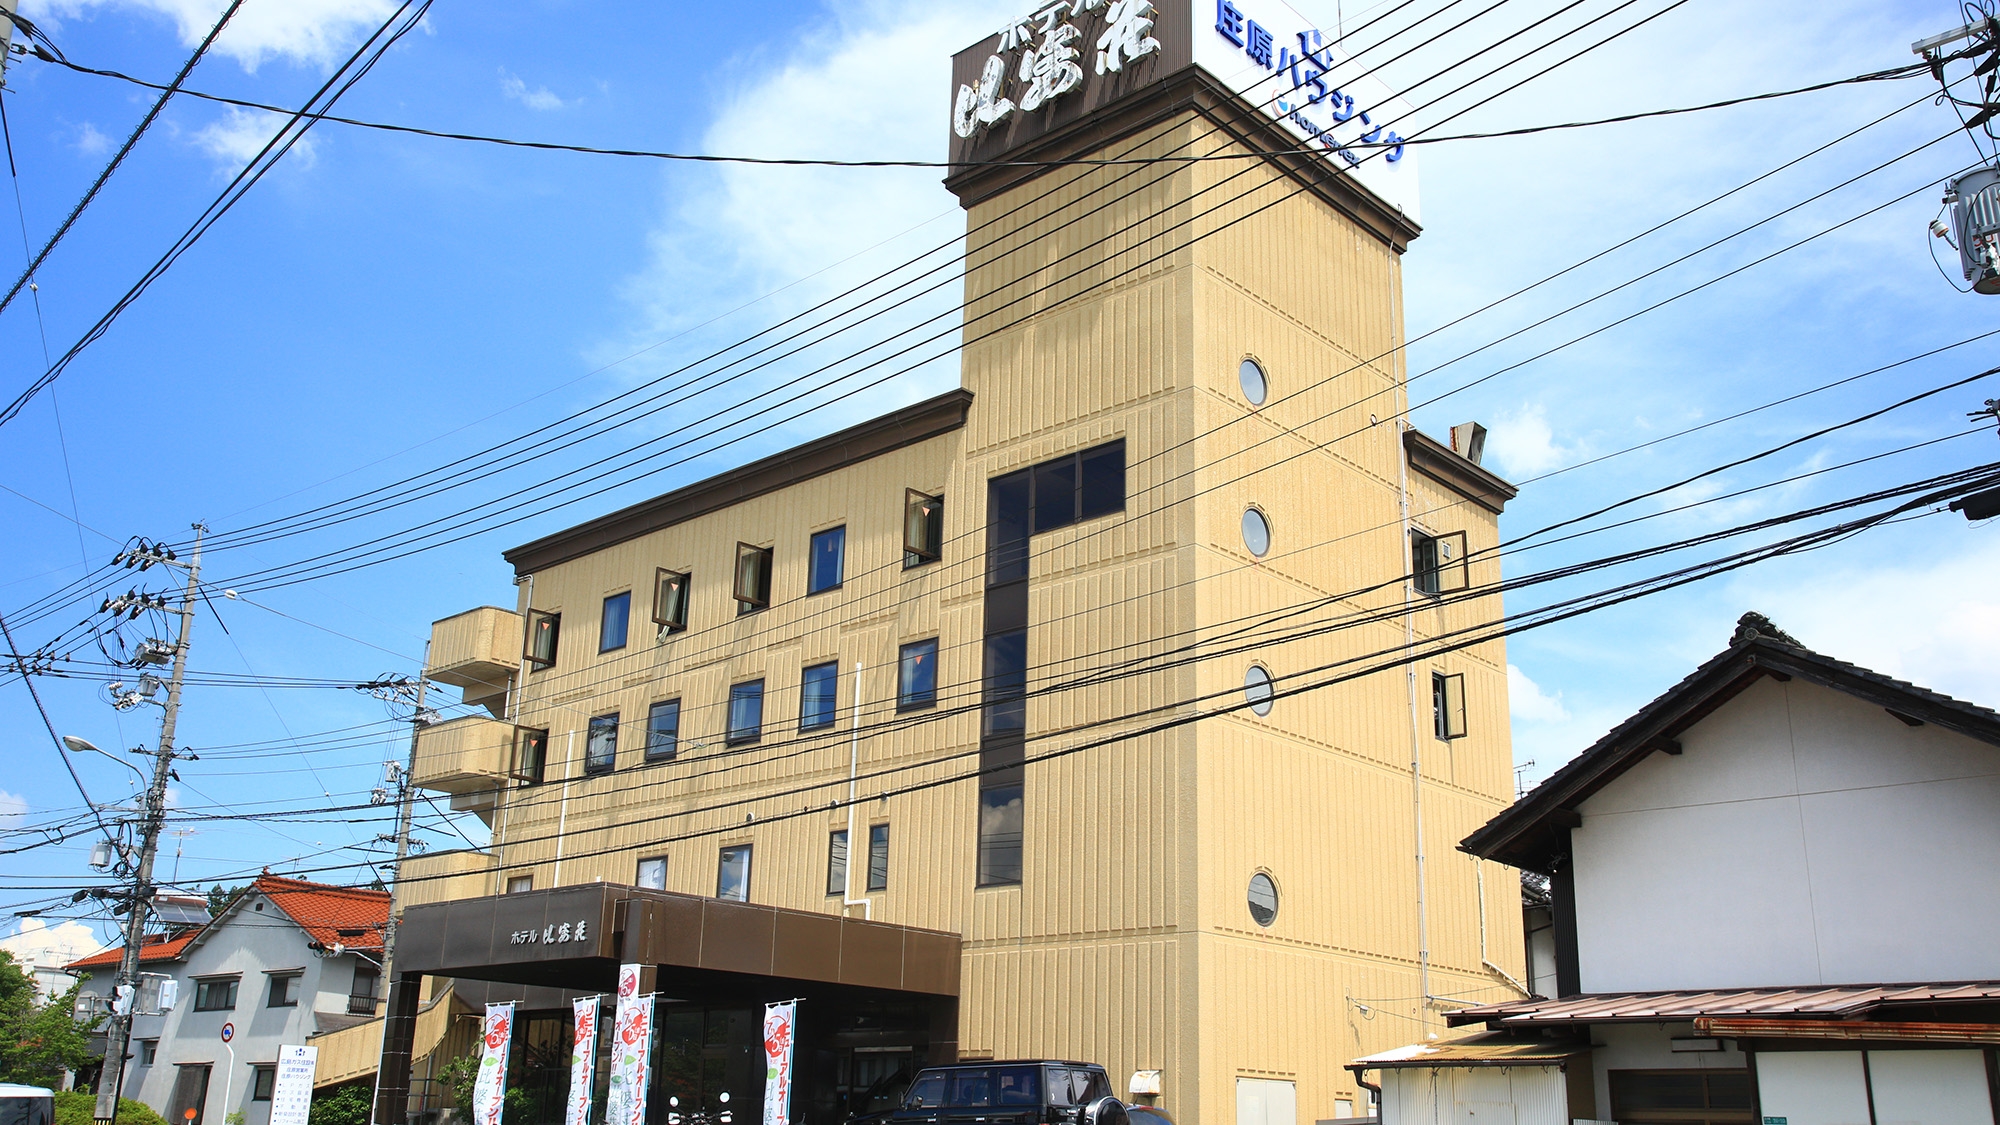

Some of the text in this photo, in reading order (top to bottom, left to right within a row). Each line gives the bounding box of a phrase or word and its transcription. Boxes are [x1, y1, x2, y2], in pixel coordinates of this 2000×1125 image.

[1215, 0, 1404, 162] 庄原ハウジング
[511, 929, 538, 945] ホテル
